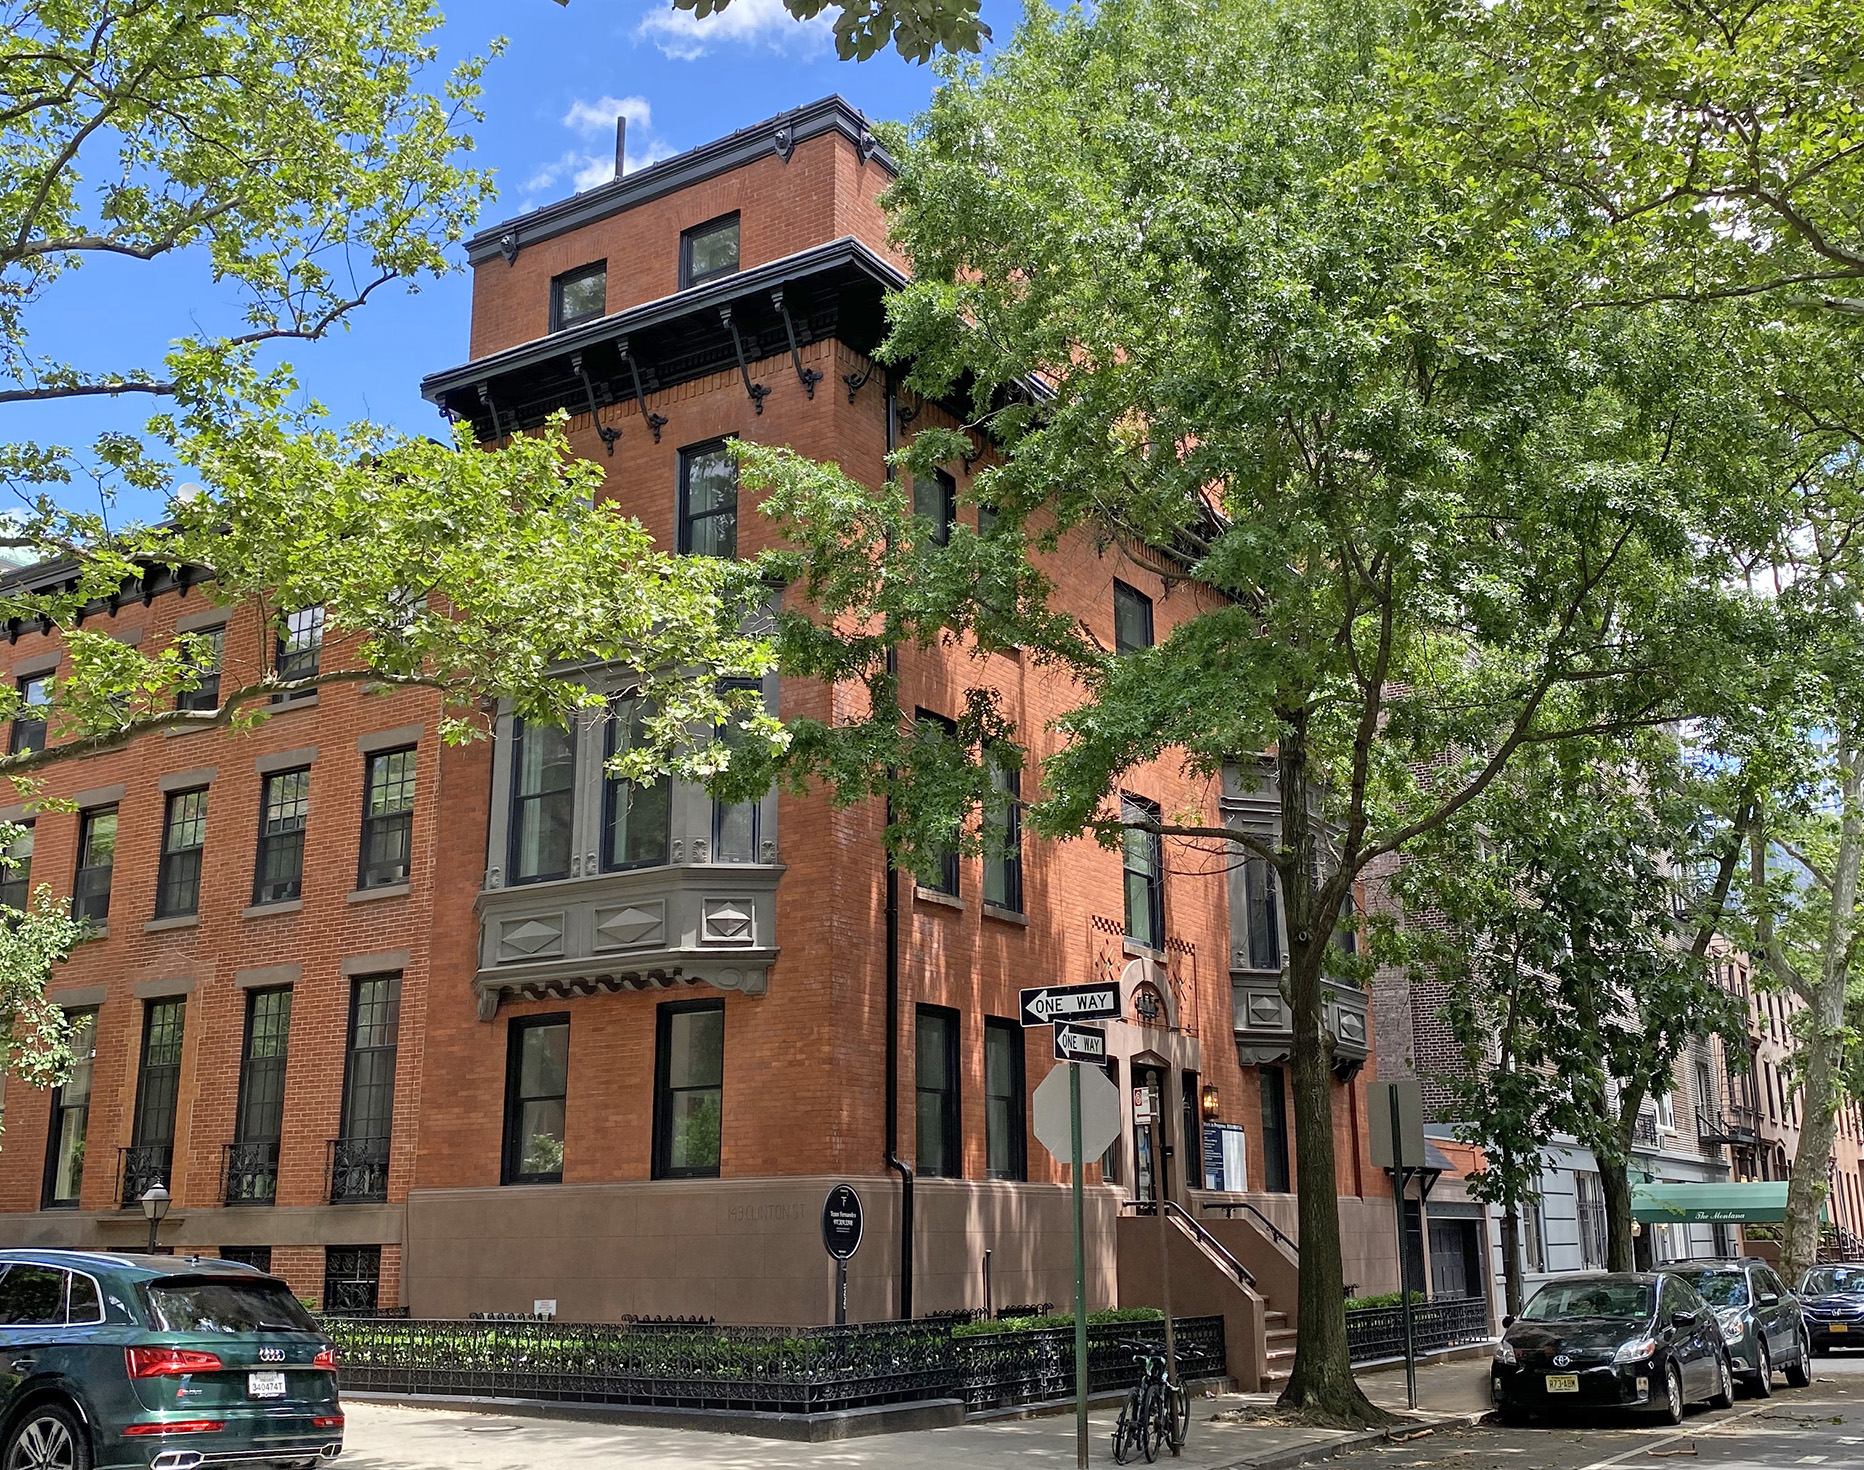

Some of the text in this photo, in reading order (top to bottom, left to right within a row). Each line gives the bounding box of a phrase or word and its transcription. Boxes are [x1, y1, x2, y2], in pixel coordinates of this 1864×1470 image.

[1035, 994, 1107, 1014] ONE WAY
[1062, 1034, 1099, 1052] ONE WAY
[1694, 1211, 1745, 1220] The Montana
